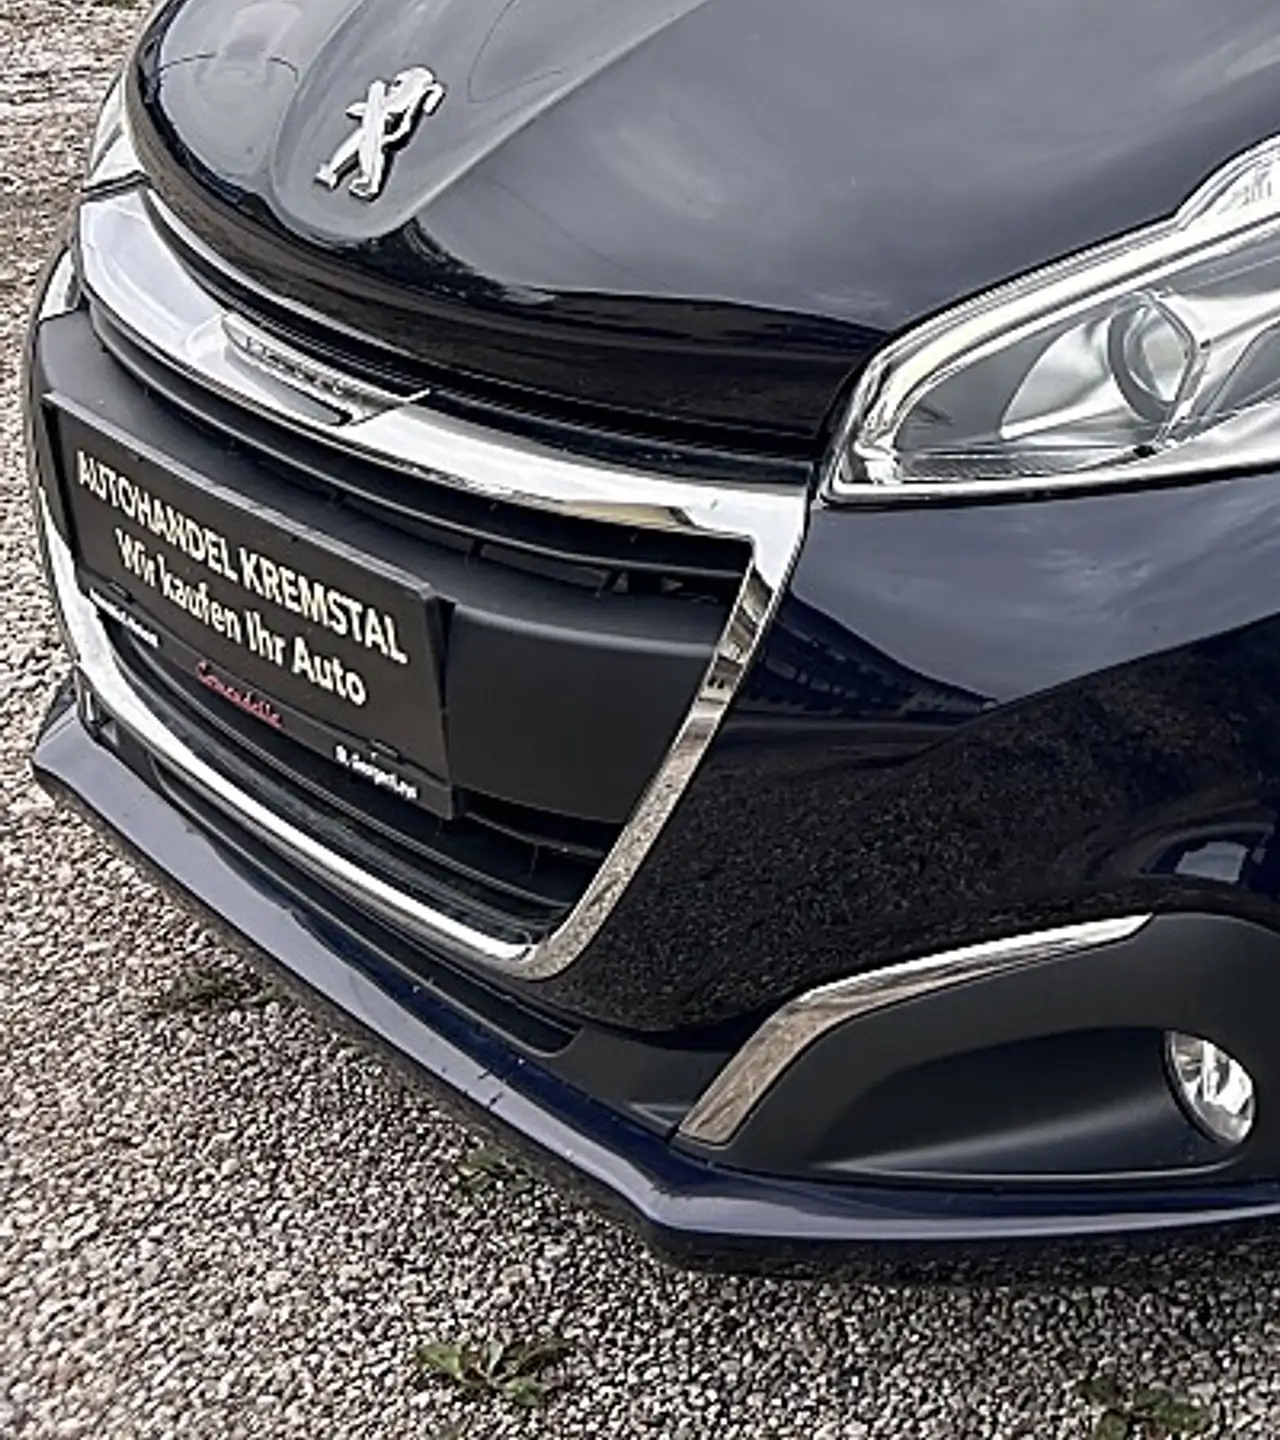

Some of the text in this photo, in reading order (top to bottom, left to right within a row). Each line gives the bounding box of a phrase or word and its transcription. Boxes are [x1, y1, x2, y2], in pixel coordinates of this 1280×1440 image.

[76, 450, 239, 584] AUTOHANDEL
[238, 547, 408, 665] KREMSTAL
[115, 527, 156, 588] Wir
[157, 553, 242, 645] kaufen
[246, 611, 286, 667] Ihr
[291, 636, 367, 707] Auto
